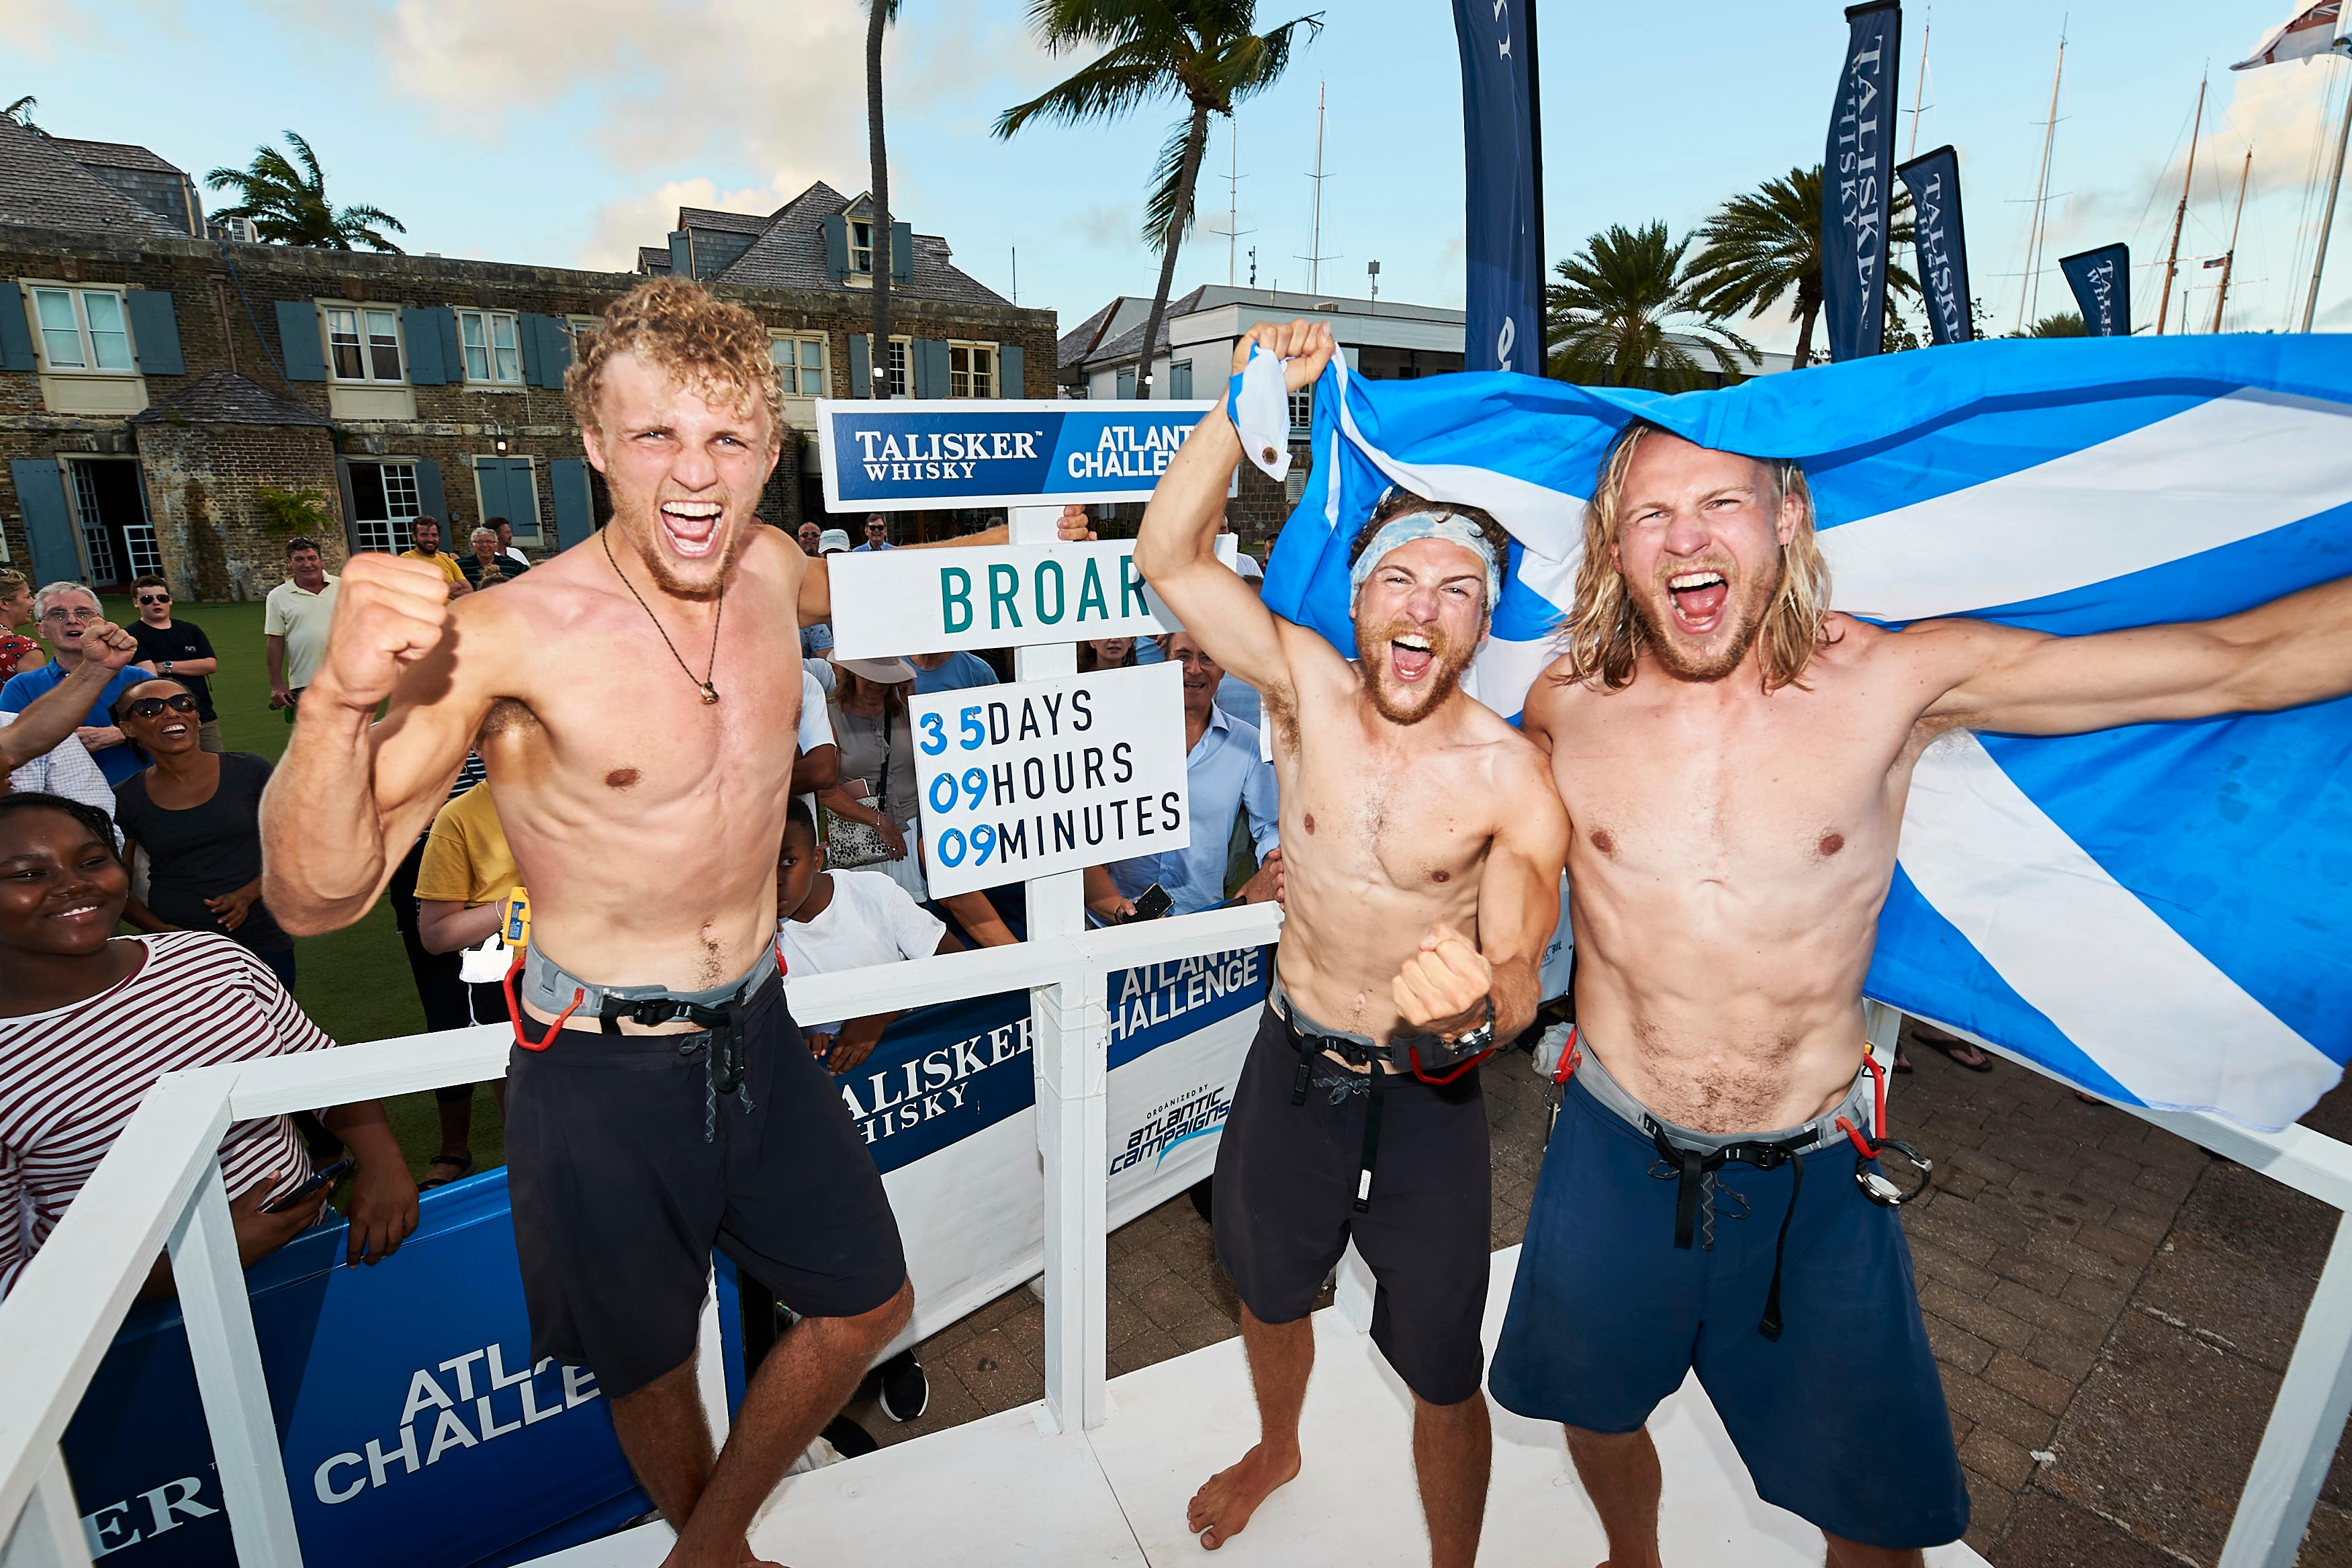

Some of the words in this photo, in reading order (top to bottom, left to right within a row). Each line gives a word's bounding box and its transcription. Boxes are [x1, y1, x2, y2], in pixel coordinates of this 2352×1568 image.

[1097, 425, 1198, 453] ATLANT
[863, 461, 977, 481] WHISKY
[940, 555, 1150, 635] BROAR
[988, 690, 1093, 745] DAYS
[993, 742, 1133, 806] HOURS
[998, 792, 1181, 864] MINUTES
[1120, 946, 1256, 1005] ATLAN
[1146, 1090, 1196, 1119] ORGANIZED
[1199, 1083, 1208, 1093] BY
